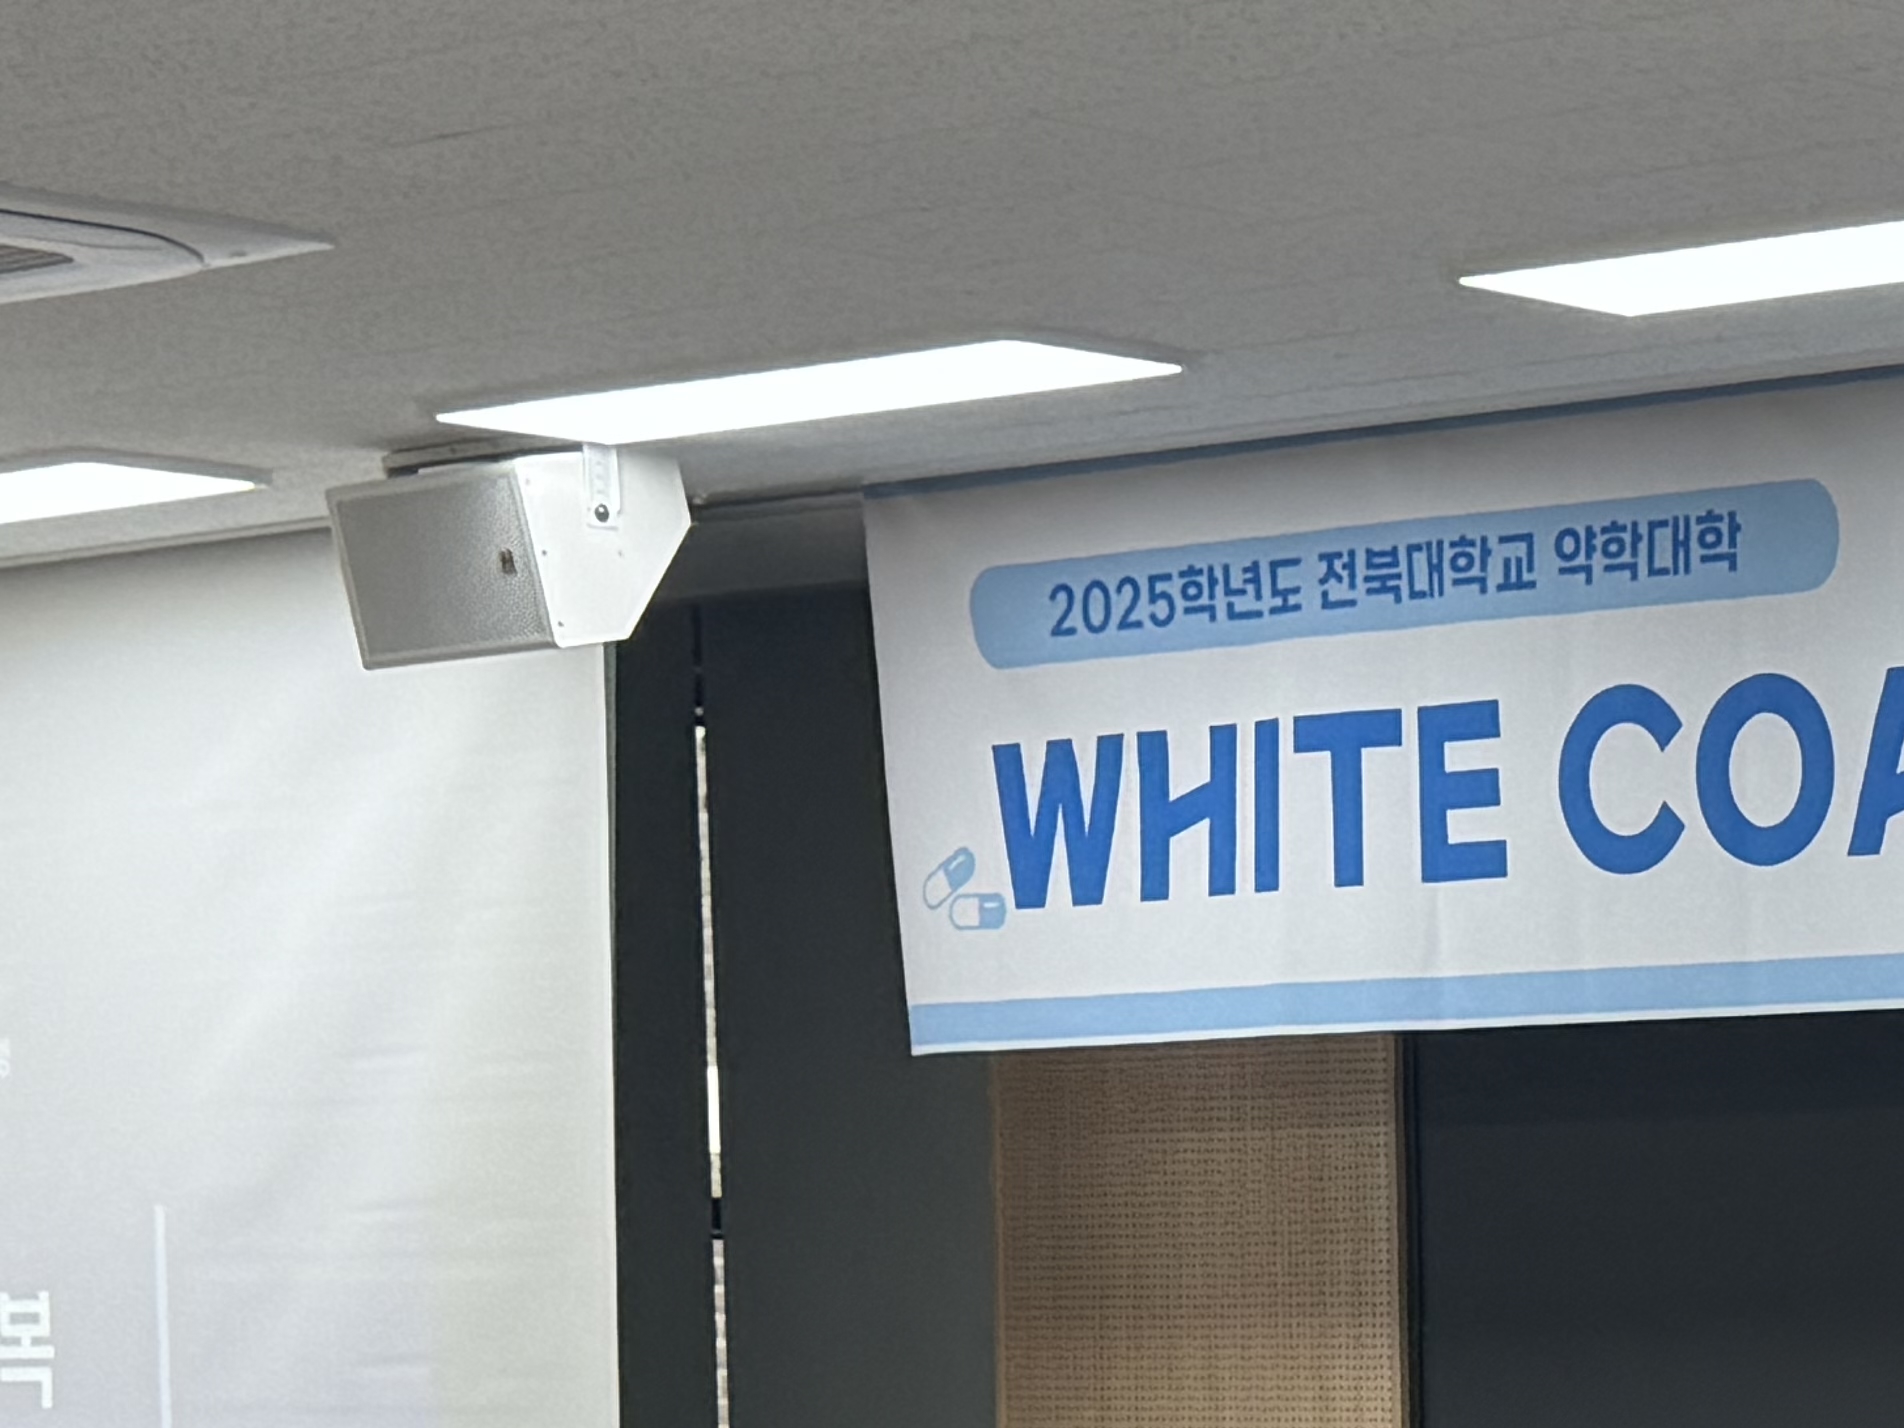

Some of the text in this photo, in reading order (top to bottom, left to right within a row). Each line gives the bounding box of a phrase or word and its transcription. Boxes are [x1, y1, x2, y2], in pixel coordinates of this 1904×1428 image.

[1049, 509, 1742, 637] 2025학년도 전북대학교 약학대학
[992, 699, 1508, 909] WHITE
